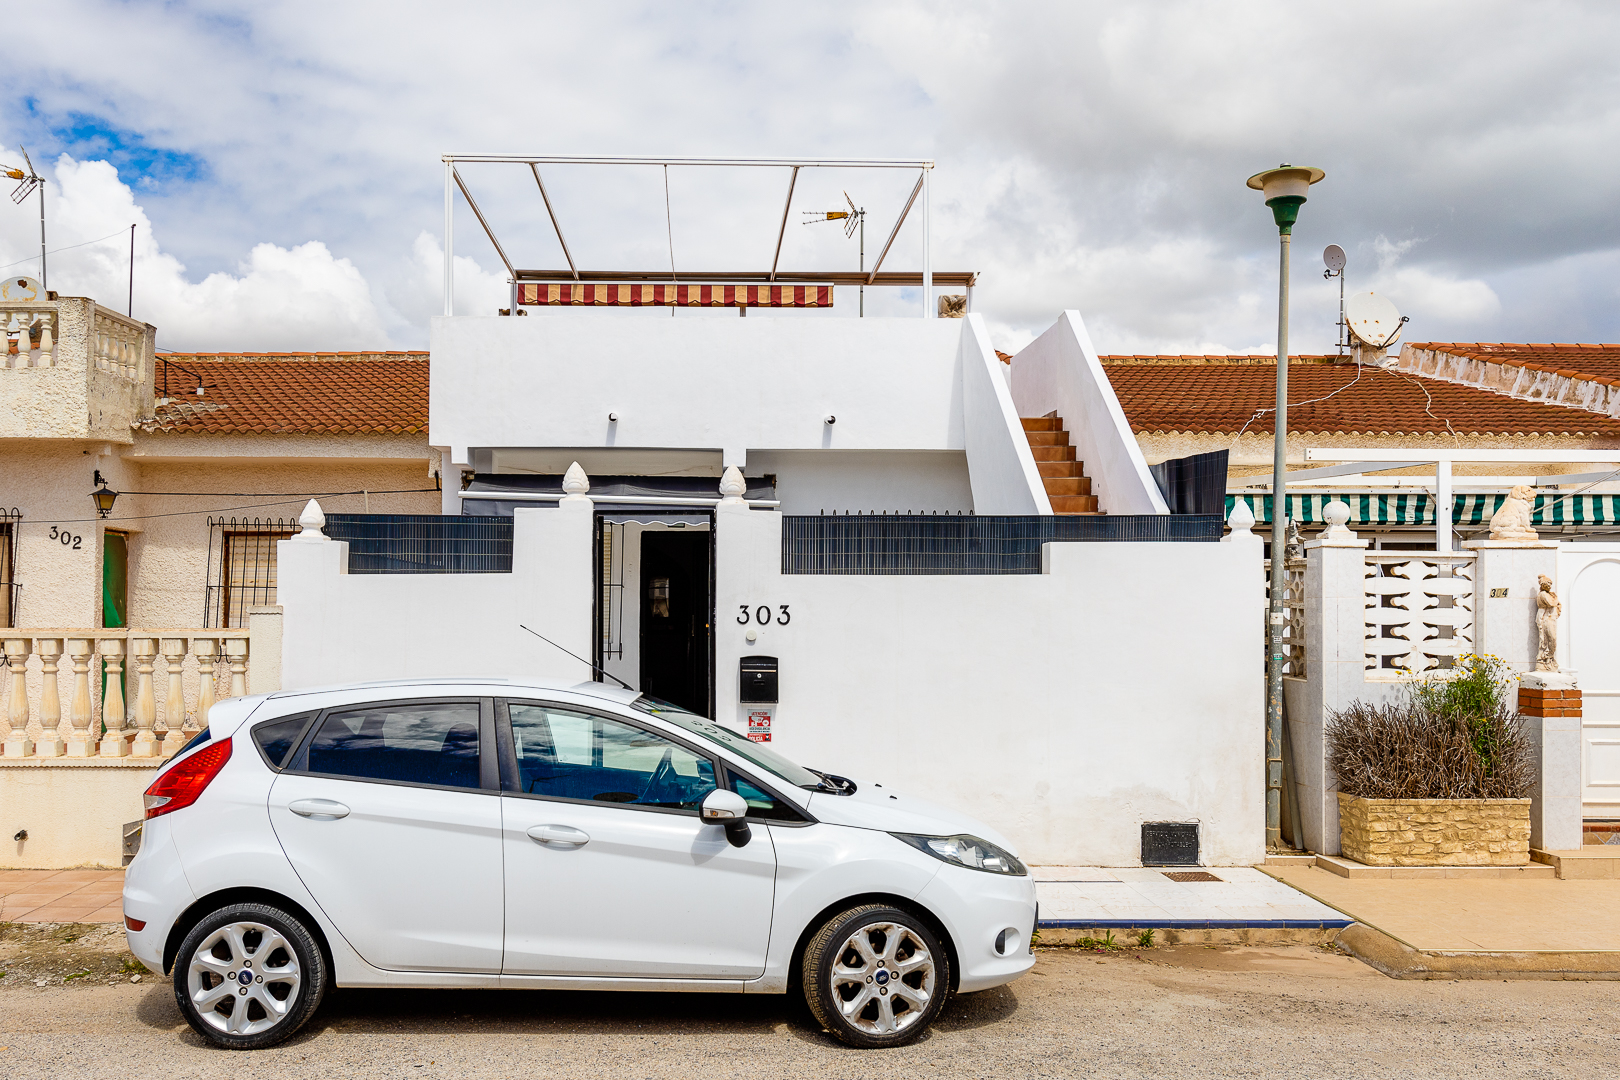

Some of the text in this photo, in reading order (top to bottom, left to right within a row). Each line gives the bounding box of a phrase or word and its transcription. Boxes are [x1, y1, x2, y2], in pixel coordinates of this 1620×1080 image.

[49, 526, 82, 550] 302
[1490, 588, 1508, 598] 304
[736, 604, 791, 626] 303
